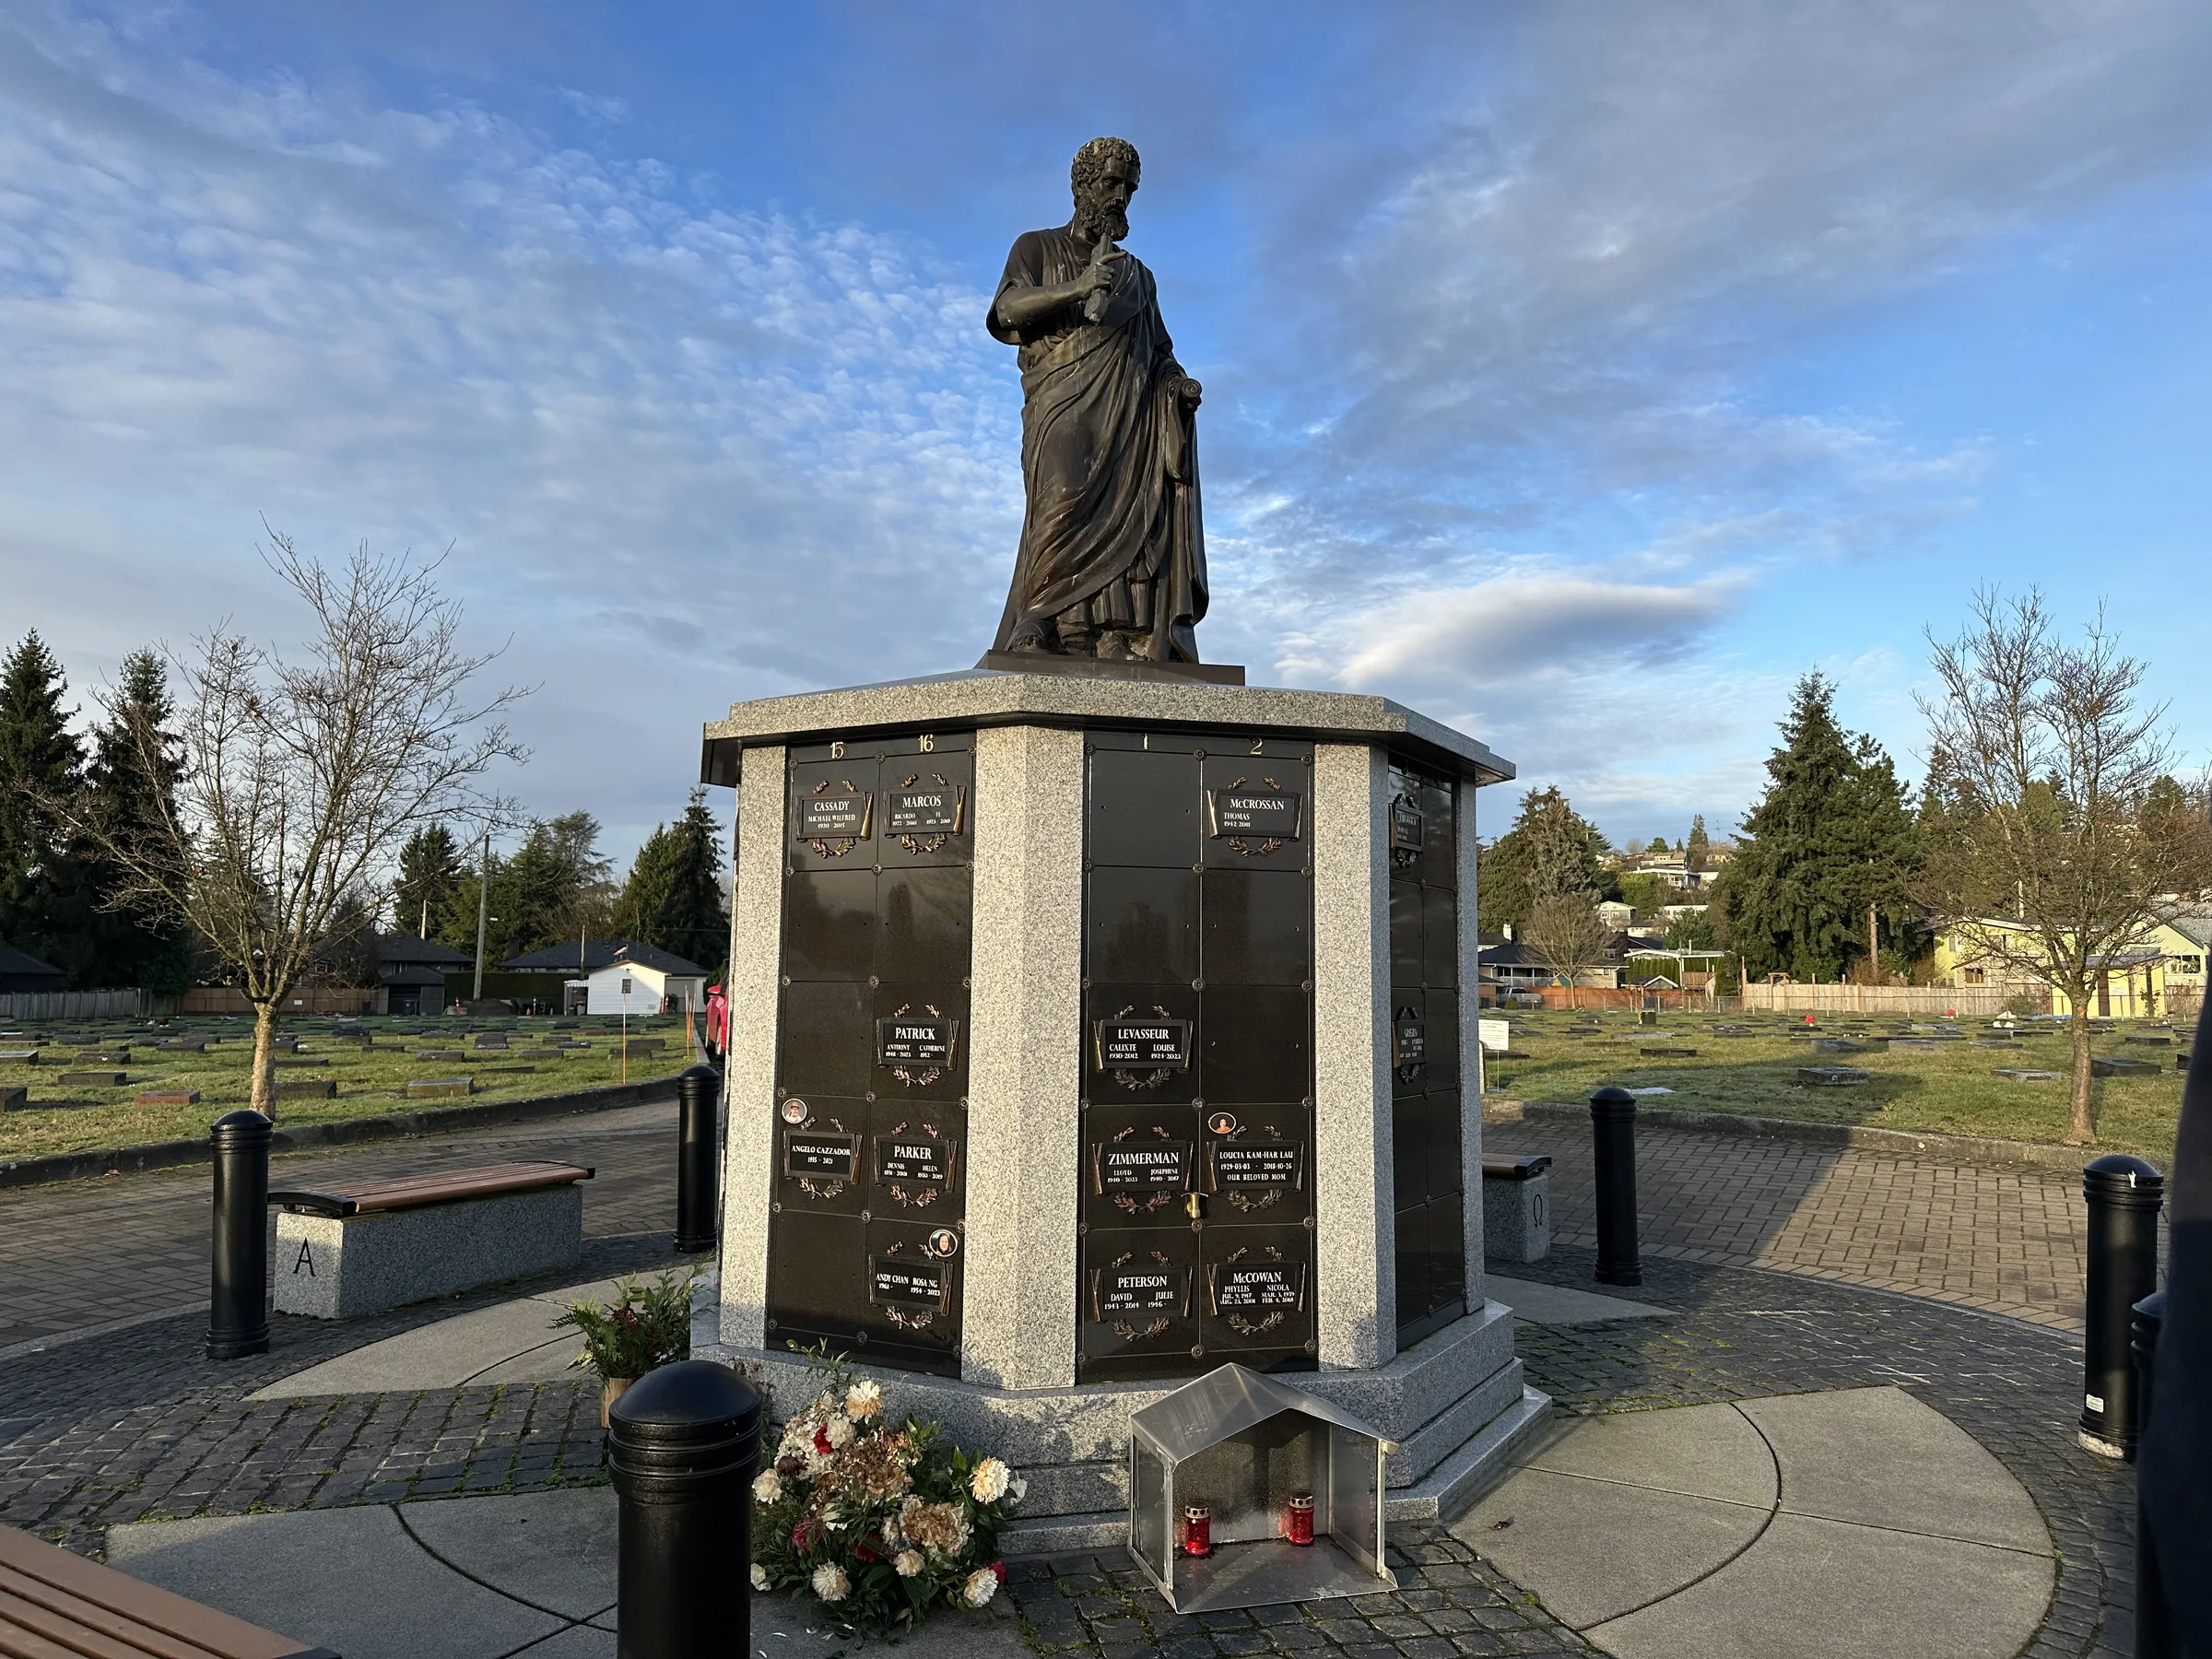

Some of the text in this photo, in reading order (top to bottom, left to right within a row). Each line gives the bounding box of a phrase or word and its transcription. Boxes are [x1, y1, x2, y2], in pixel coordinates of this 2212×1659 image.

[918, 734, 934, 752] 16
[1141, 733, 1148, 749] 1
[1250, 737, 1264, 754] 2
[830, 742, 844, 759] 15
[814, 801, 850, 811] CASSADY
[902, 795, 942, 807] MARCOS
[1230, 798, 1284, 810] McCROSSAN
[1223, 812, 1250, 820] THOMAS
[895, 1027, 935, 1040] PATRICK
[1118, 1029, 1170, 1039] LEVASSEUR
[792, 1145, 851, 1156] ANGELO CAZZADOR
[894, 1145, 932, 1159] PARKER
[1219, 1151, 1244, 1159] LOUCIA
[1108, 1152, 1179, 1165] ZIMMERMAN
[292, 1237, 316, 1277] A
[876, 1273, 909, 1285] ANDY CHAN
[912, 1277, 938, 1288] ROSA NG
[1117, 1276, 1168, 1288] PETERSON
[1232, 1272, 1282, 1283] McCOWAN
[1111, 1293, 1133, 1301] DAVID
[1155, 1291, 1174, 1300] JULIE
